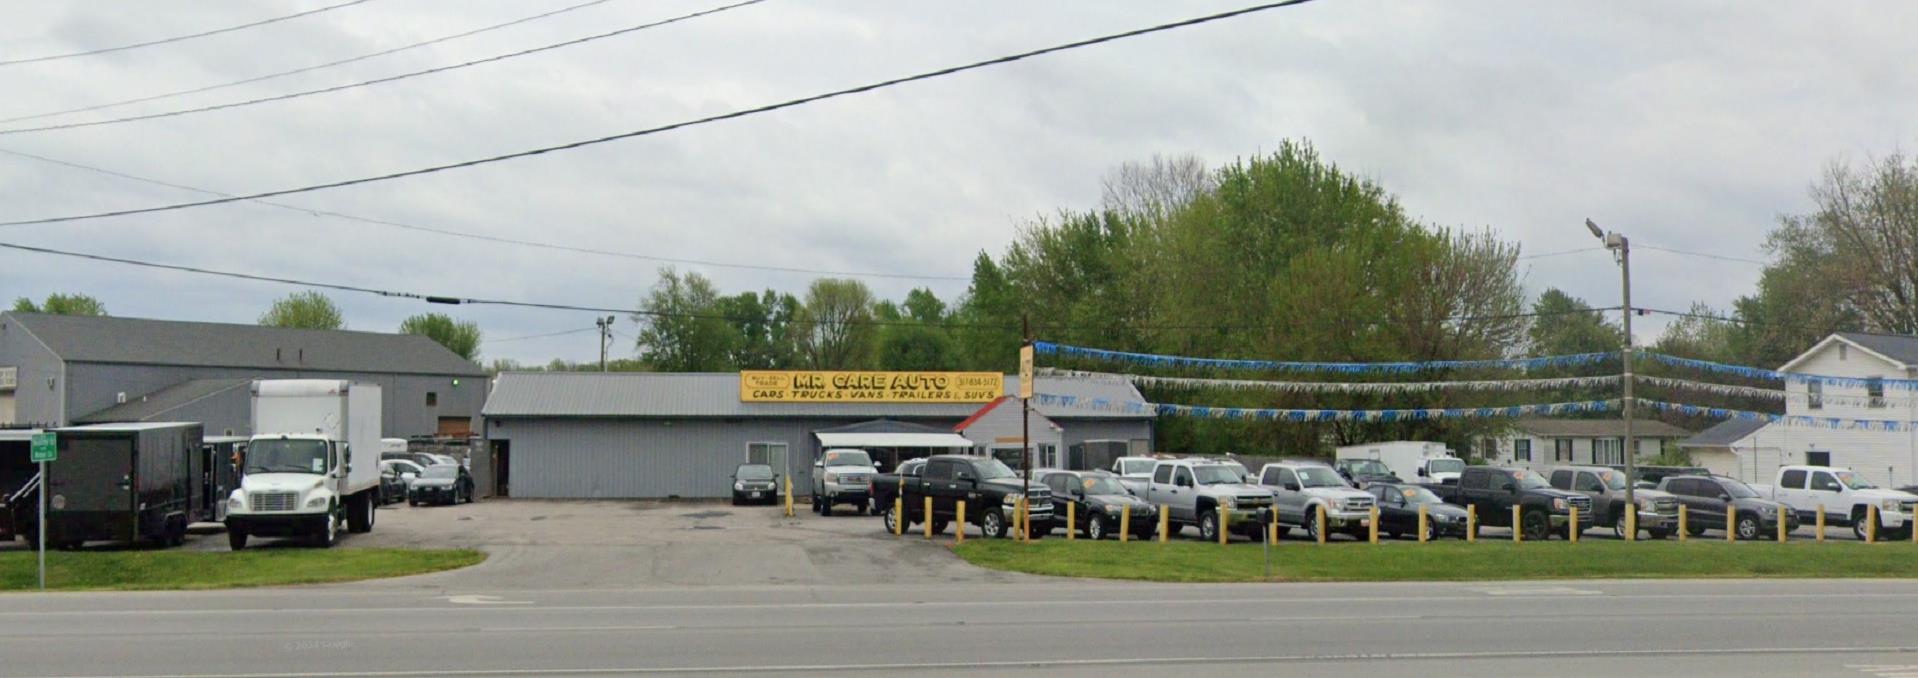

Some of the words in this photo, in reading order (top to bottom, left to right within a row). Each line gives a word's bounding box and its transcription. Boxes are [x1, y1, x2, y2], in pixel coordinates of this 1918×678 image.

[832, 374, 886, 390] CARE
[889, 374, 948, 390] AUTO
[752, 390, 784, 399] CARS
[791, 390, 842, 399] TRUCKS
[850, 390, 884, 399] VANS
[892, 390, 951, 399] TRAILERS
